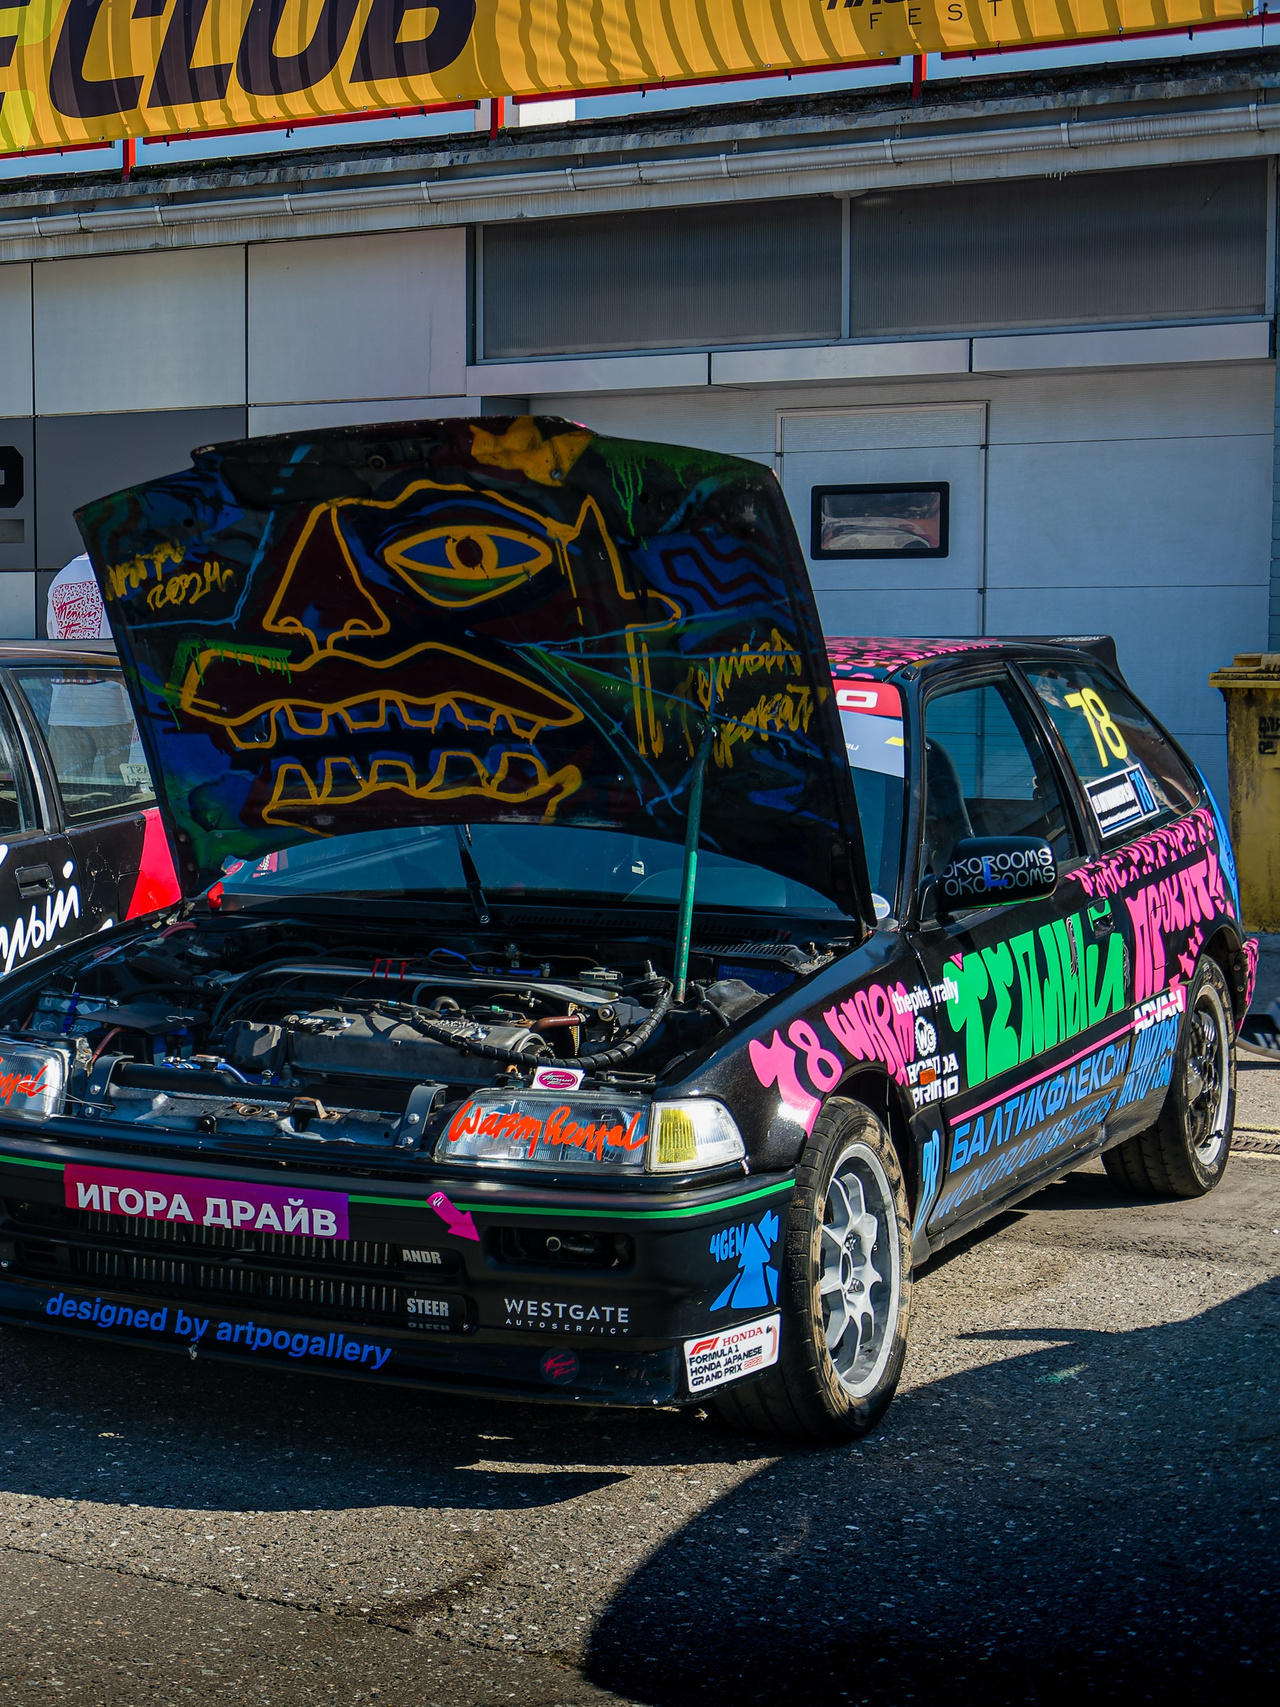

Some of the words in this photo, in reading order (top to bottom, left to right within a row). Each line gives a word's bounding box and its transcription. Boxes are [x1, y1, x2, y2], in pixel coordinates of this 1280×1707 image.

[869, 0, 1003, 30] FEST
[49, 0, 477, 119] CLUB
[1064, 687, 1128, 768] 78
[1129, 770, 1155, 813] 78
[1134, 989, 1184, 1035] ADVAN
[749, 1020, 843, 1138] 78
[448, 1100, 543, 1158] Warm
[544, 1106, 650, 1161] Rental
[949, 1044, 1116, 1174] БАЛТИКФЛЕКС
[77, 1182, 193, 1223] ИГОРА
[203, 1197, 339, 1238] ДРАЙВ
[402, 1249, 442, 1265] ANDR
[406, 1298, 449, 1317] STEER
[504, 1298, 629, 1323] WESTGATE
[46, 1293, 167, 1334] designed
[175, 1309, 210, 1342] by
[216, 1318, 392, 1370] artpogallery
[723, 1327, 763, 1347] HONDA
[689, 1347, 734, 1366] FORMULA
[734, 1344, 740, 1353] 1
[690, 1359, 722, 1377] HONDA
[723, 1346, 763, 1367] JAPANESE
[691, 1370, 723, 1387] GRAND
[724, 1362, 743, 1377] PRIX
